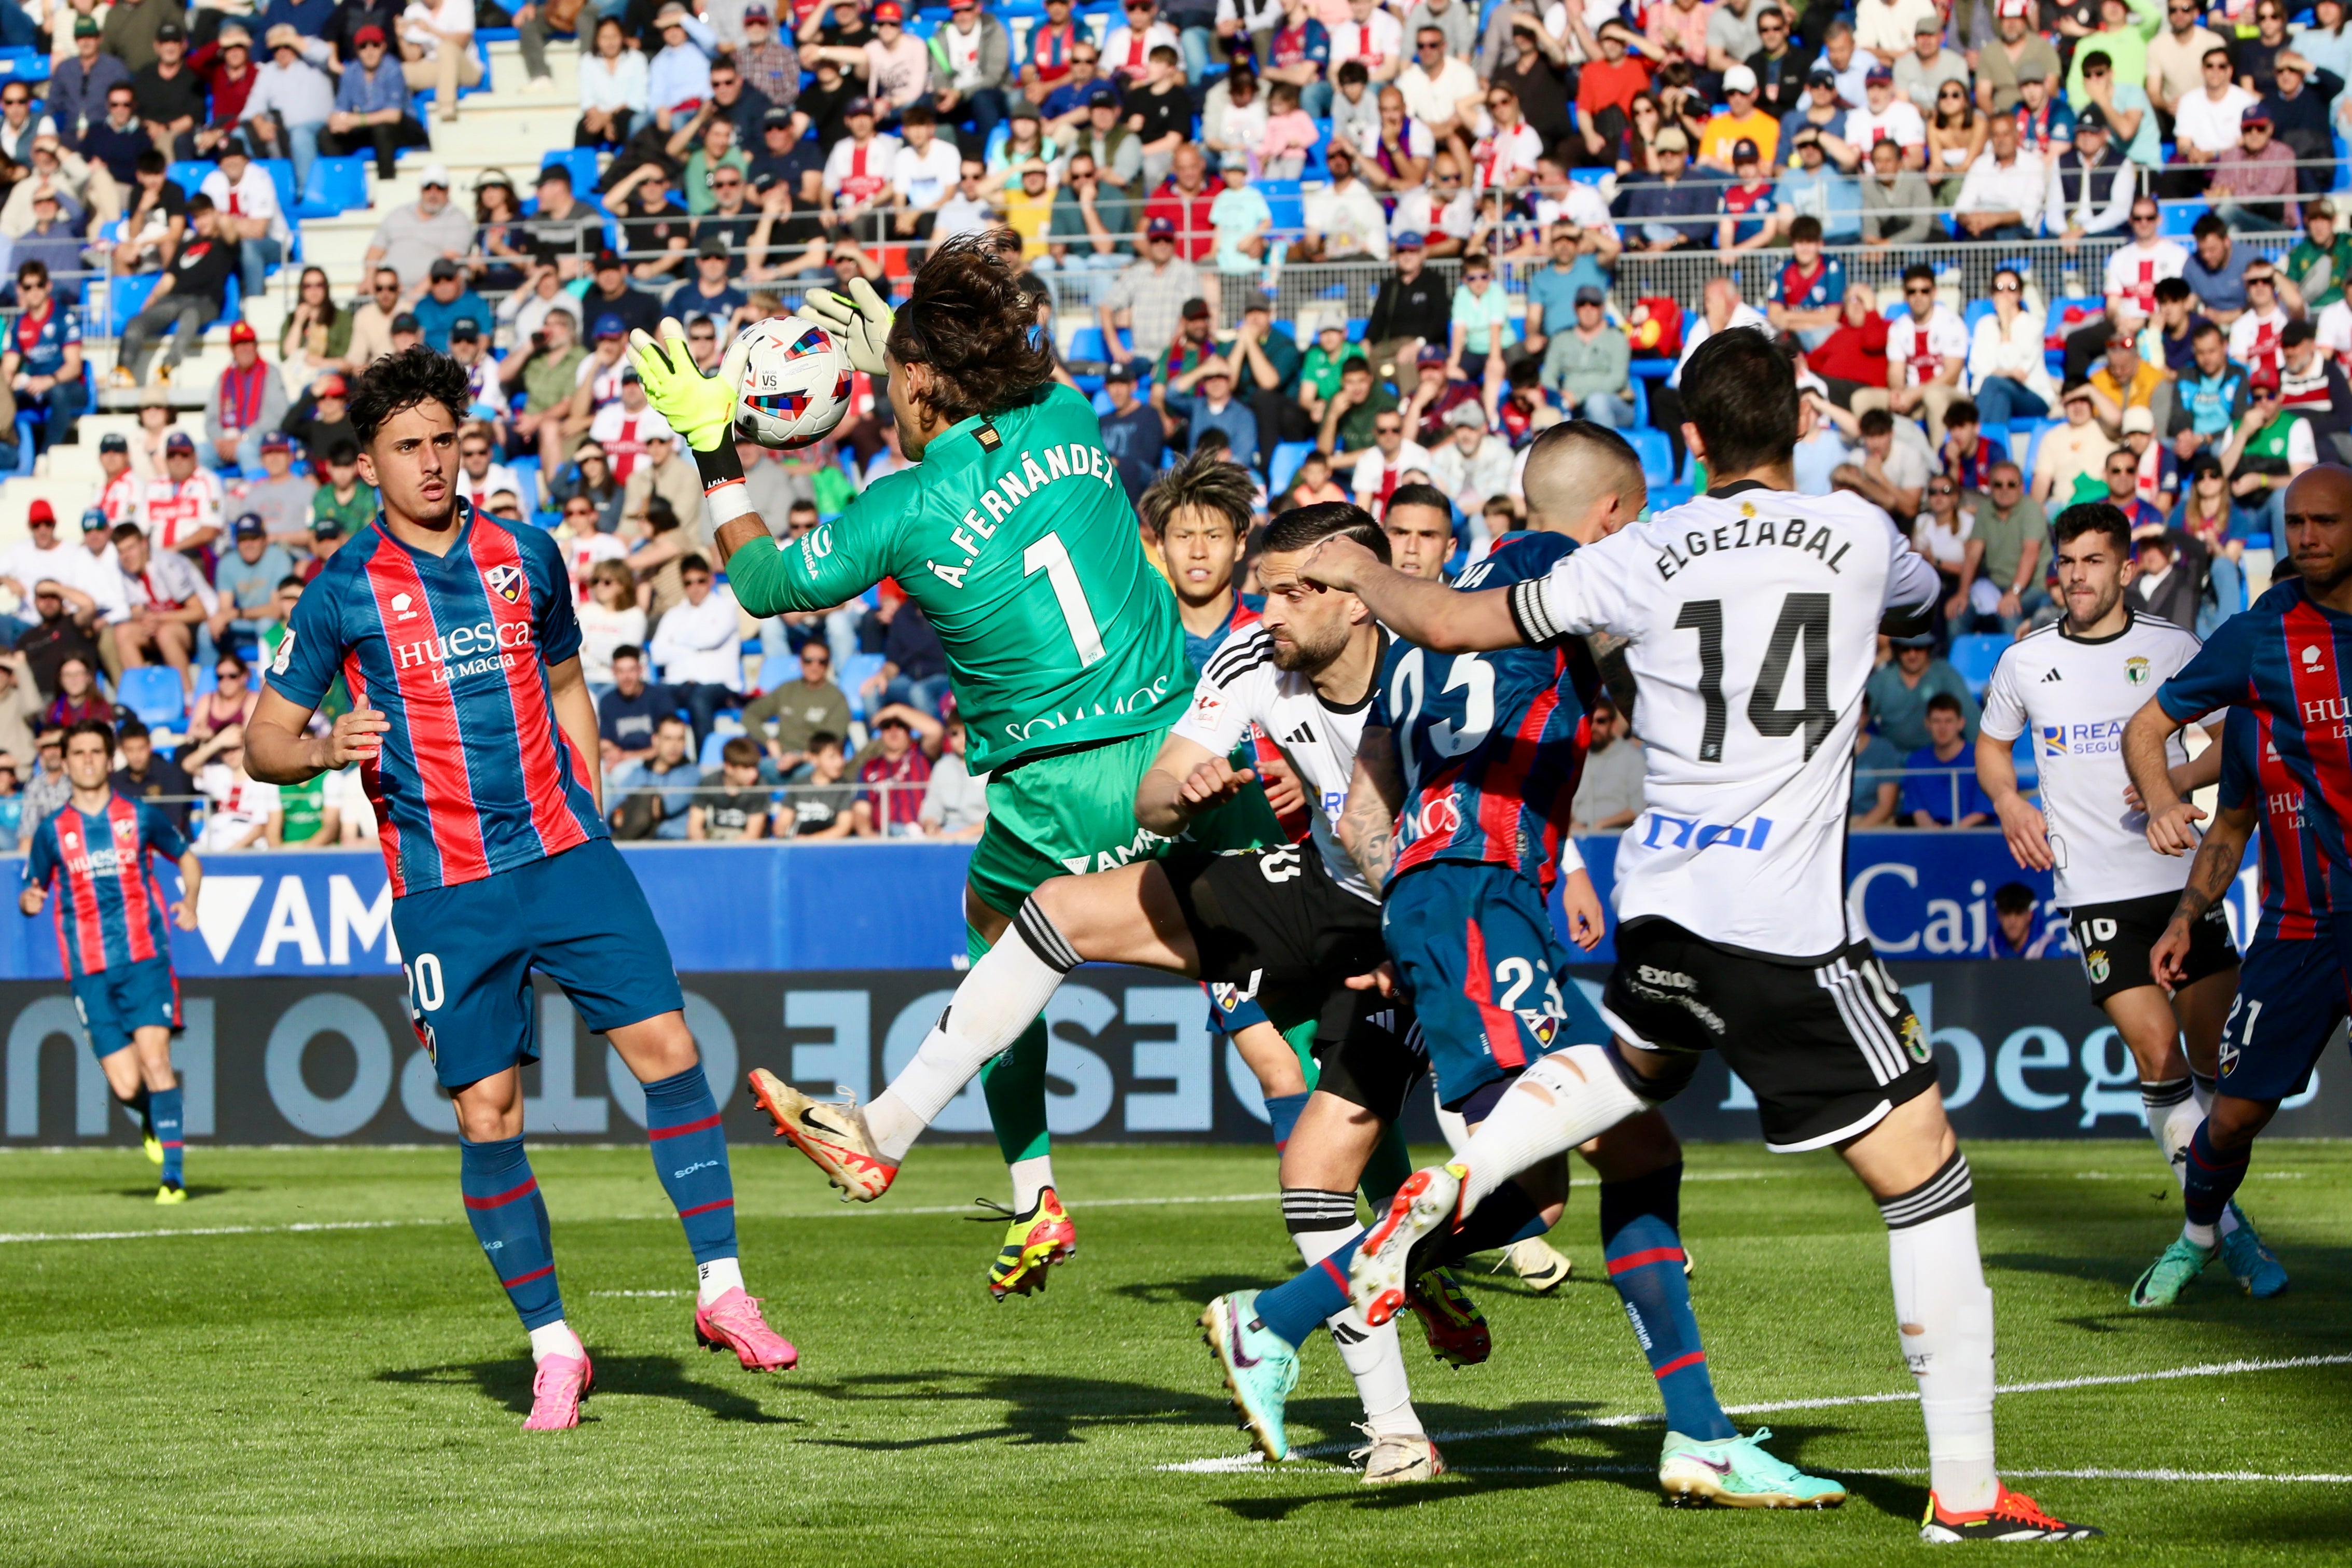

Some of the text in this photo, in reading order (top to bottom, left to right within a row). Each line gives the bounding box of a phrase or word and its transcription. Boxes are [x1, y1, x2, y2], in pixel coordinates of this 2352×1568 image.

[762, 375, 777, 386] VS
[926, 442, 1113, 589] Á.FERNÁNDEZ
[800, 532, 819, 580] OSEHISA
[1655, 518, 1853, 581] ELGEZABAL
[1022, 530, 1106, 669] 1
[396, 621, 530, 669] Huesca
[1673, 592, 1839, 764] 14
[2302, 696, 2352, 724] Hu
[2073, 720, 2128, 740] REA
[2074, 741, 2120, 755] SEGU
[2269, 792, 2305, 814] Hu
[255, 874, 403, 966] AM
[1495, 956, 1568, 1020] 23
[2222, 992, 2264, 1047] 21
[674, 1159, 719, 1180] soka
[481, 1240, 504, 1251] ka
[700, 1262, 710, 1280] NE
[1905, 1353, 1934, 1367] CF
